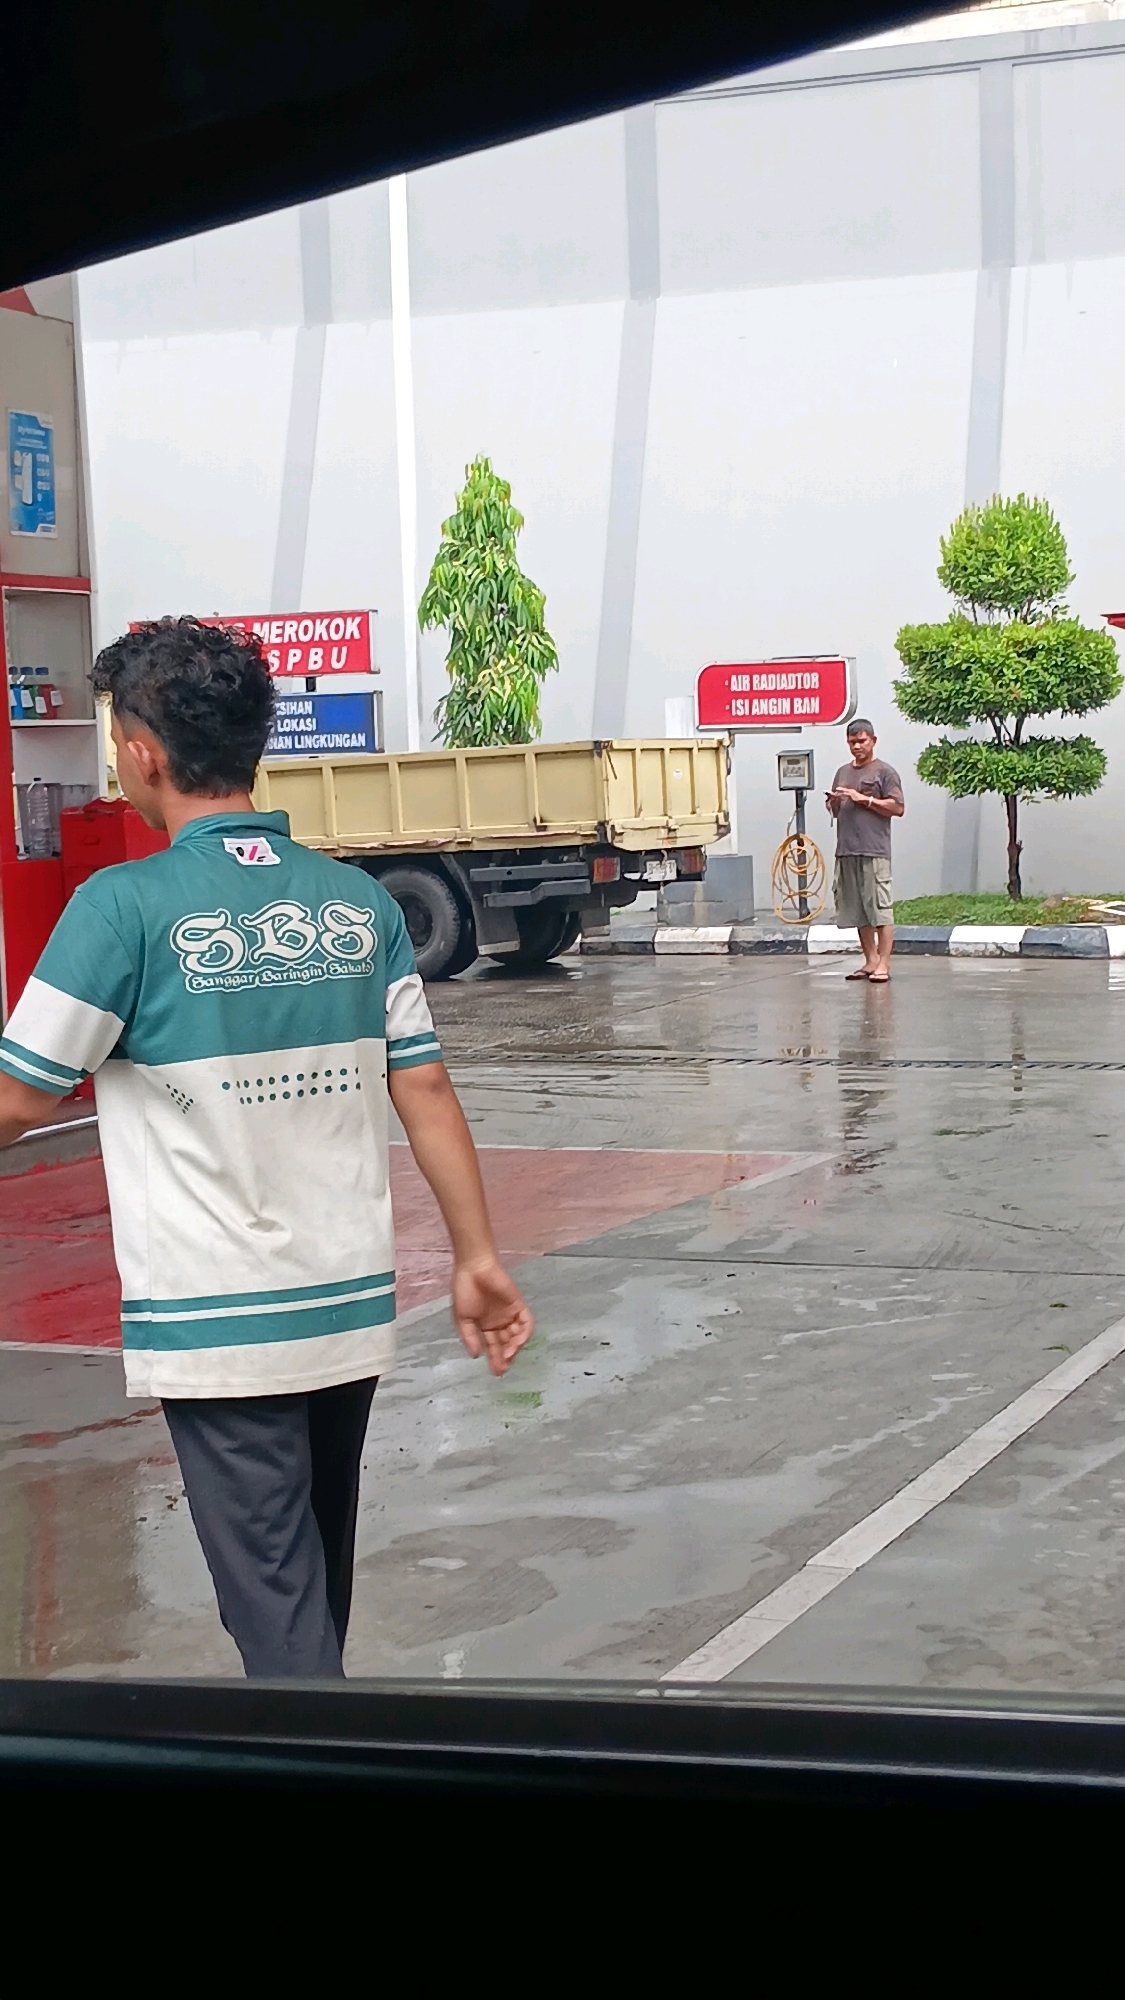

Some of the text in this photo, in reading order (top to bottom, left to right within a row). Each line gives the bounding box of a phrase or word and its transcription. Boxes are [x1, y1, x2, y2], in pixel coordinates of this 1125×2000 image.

[252, 617, 362, 644] MEROKOK
[731, 672, 819, 691] AIR RADIADTOR
[275, 701, 312, 715] SIHAN
[731, 697, 819, 716] ISI ANGIN BAN
[277, 718, 316, 732] LOKASI
[294, 733, 365, 749] LINGKUNGAN
[170, 900, 378, 975] SBS
[191, 974, 254, 988] Sanggar
